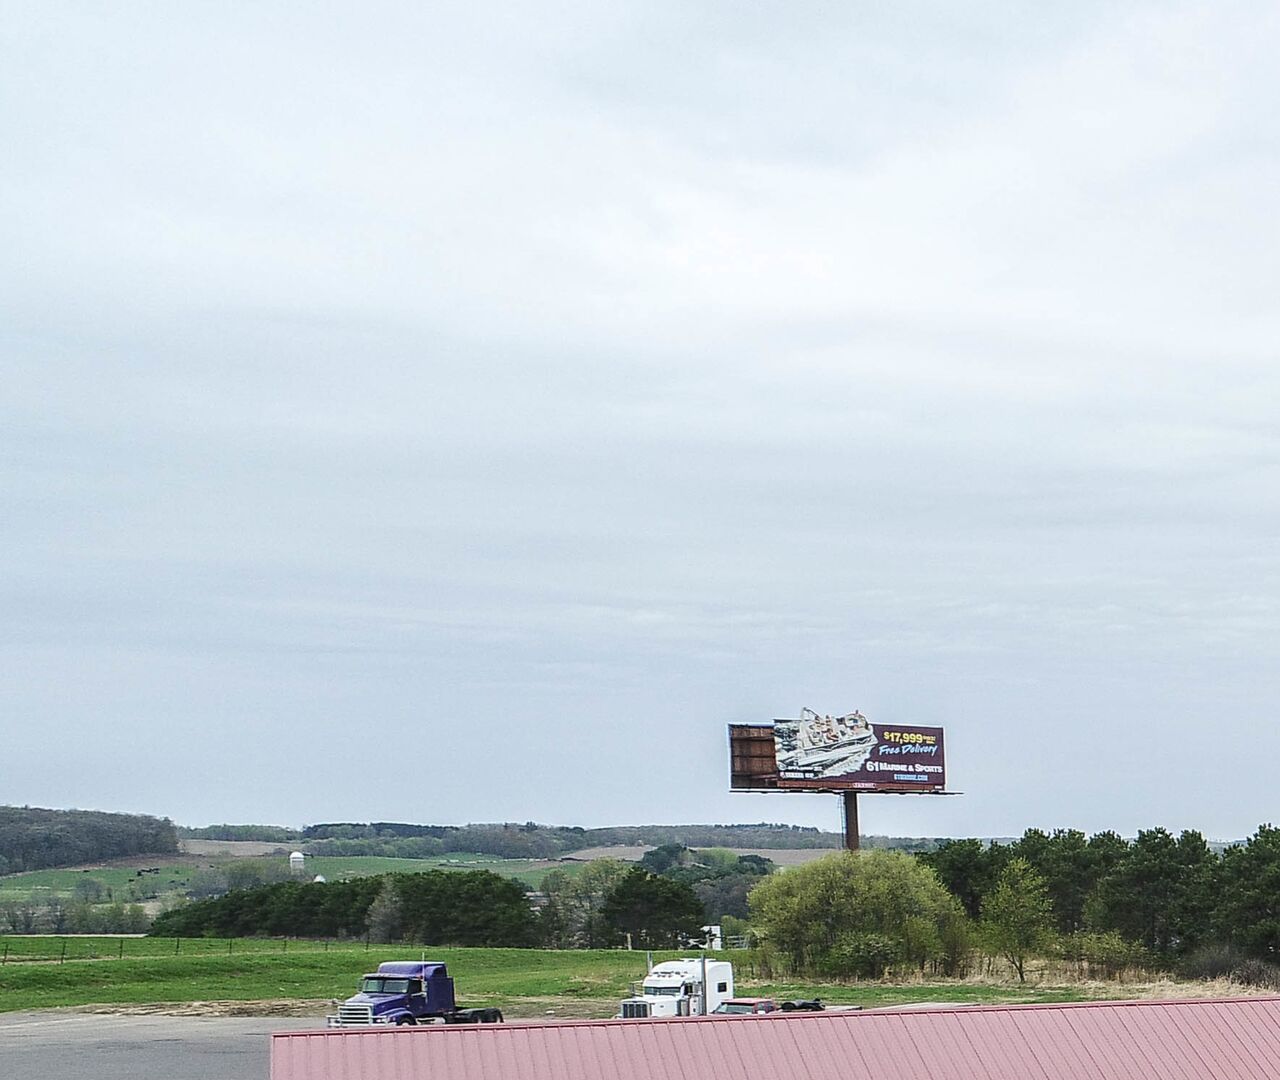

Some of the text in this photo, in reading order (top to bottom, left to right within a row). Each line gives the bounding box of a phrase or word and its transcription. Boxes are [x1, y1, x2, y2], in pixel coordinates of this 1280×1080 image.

[883, 731, 923, 744] $17,999
[879, 744, 938, 757] Free Delivery
[866, 761, 879, 771] 61
